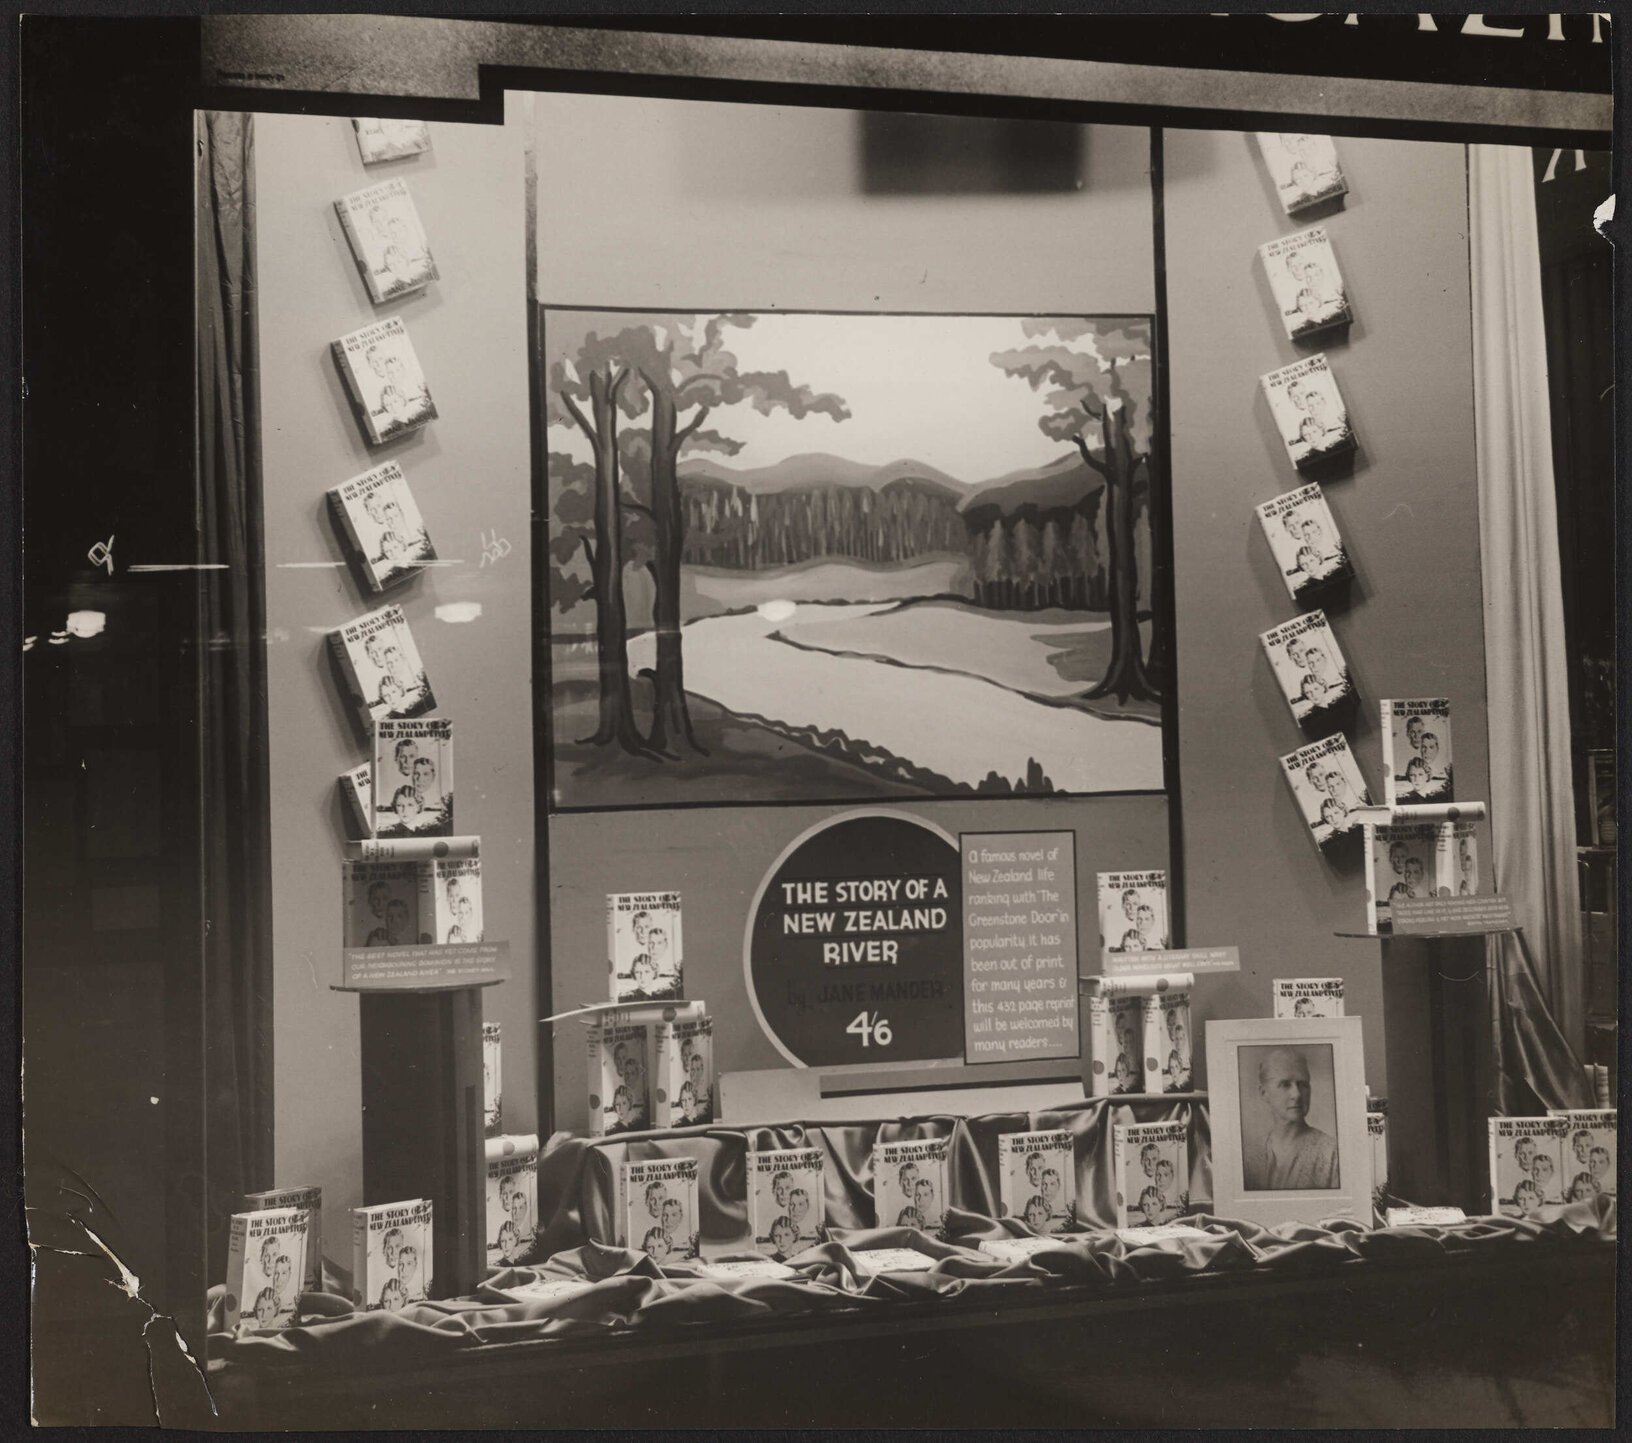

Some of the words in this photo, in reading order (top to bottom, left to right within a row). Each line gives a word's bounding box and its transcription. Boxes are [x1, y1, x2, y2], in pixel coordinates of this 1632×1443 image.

[380, 723, 393, 731] THE
[981, 849, 1017, 863] famous
[1018, 848, 1044, 862] novel
[1047, 847, 1060, 861] of
[968, 869, 991, 884] New
[992, 867, 1034, 883] Zealand
[1036, 866, 1055, 881] life
[782, 883, 828, 904] THE
[835, 880, 901, 902] STORY
[905, 879, 929, 899] OF
[933, 877, 949, 899] A
[968, 891, 1011, 908] ranking
[1012, 889, 1037, 904] with
[784, 913, 836, 934] NEW
[843, 908, 947, 931] ZEALAND
[968, 911, 1028, 927] Greenstone
[1060, 912, 1070, 923] in
[1040, 933, 1062, 946] has
[823, 941, 898, 965] RIVER
[971, 956, 998, 972] been
[999, 957, 1018, 971] out
[1020, 954, 1033, 970] of
[1036, 953, 1064, 971] print
[818, 983, 866, 1004] JANE
[870, 979, 944, 1001] MANDER
[971, 977, 988, 992] for
[990, 980, 1021, 994] many
[1023, 977, 1056, 993] years
[972, 999, 994, 1014] this
[996, 1000, 1017, 1012] 432
[1018, 999, 1044, 1014] page
[1045, 994, 1076, 1012] reprint
[845, 1010, 893, 1048] 4/6
[973, 1016, 993, 1033] will
[994, 1016, 1008, 1032] be
[1009, 1014, 1060, 1030] welcomed
[1061, 1014, 1074, 1032] by
[973, 1040, 1007, 1053] many
[885, 1147, 897, 1155] THE
[758, 1156, 771, 1164] THE
[631, 1166, 643, 1175] THE
[251, 1220, 263, 1229] THE
[266, 1216, 286, 1227] STORY
[372, 1212, 384, 1222] THE
[387, 1208, 408, 1220] STORY
